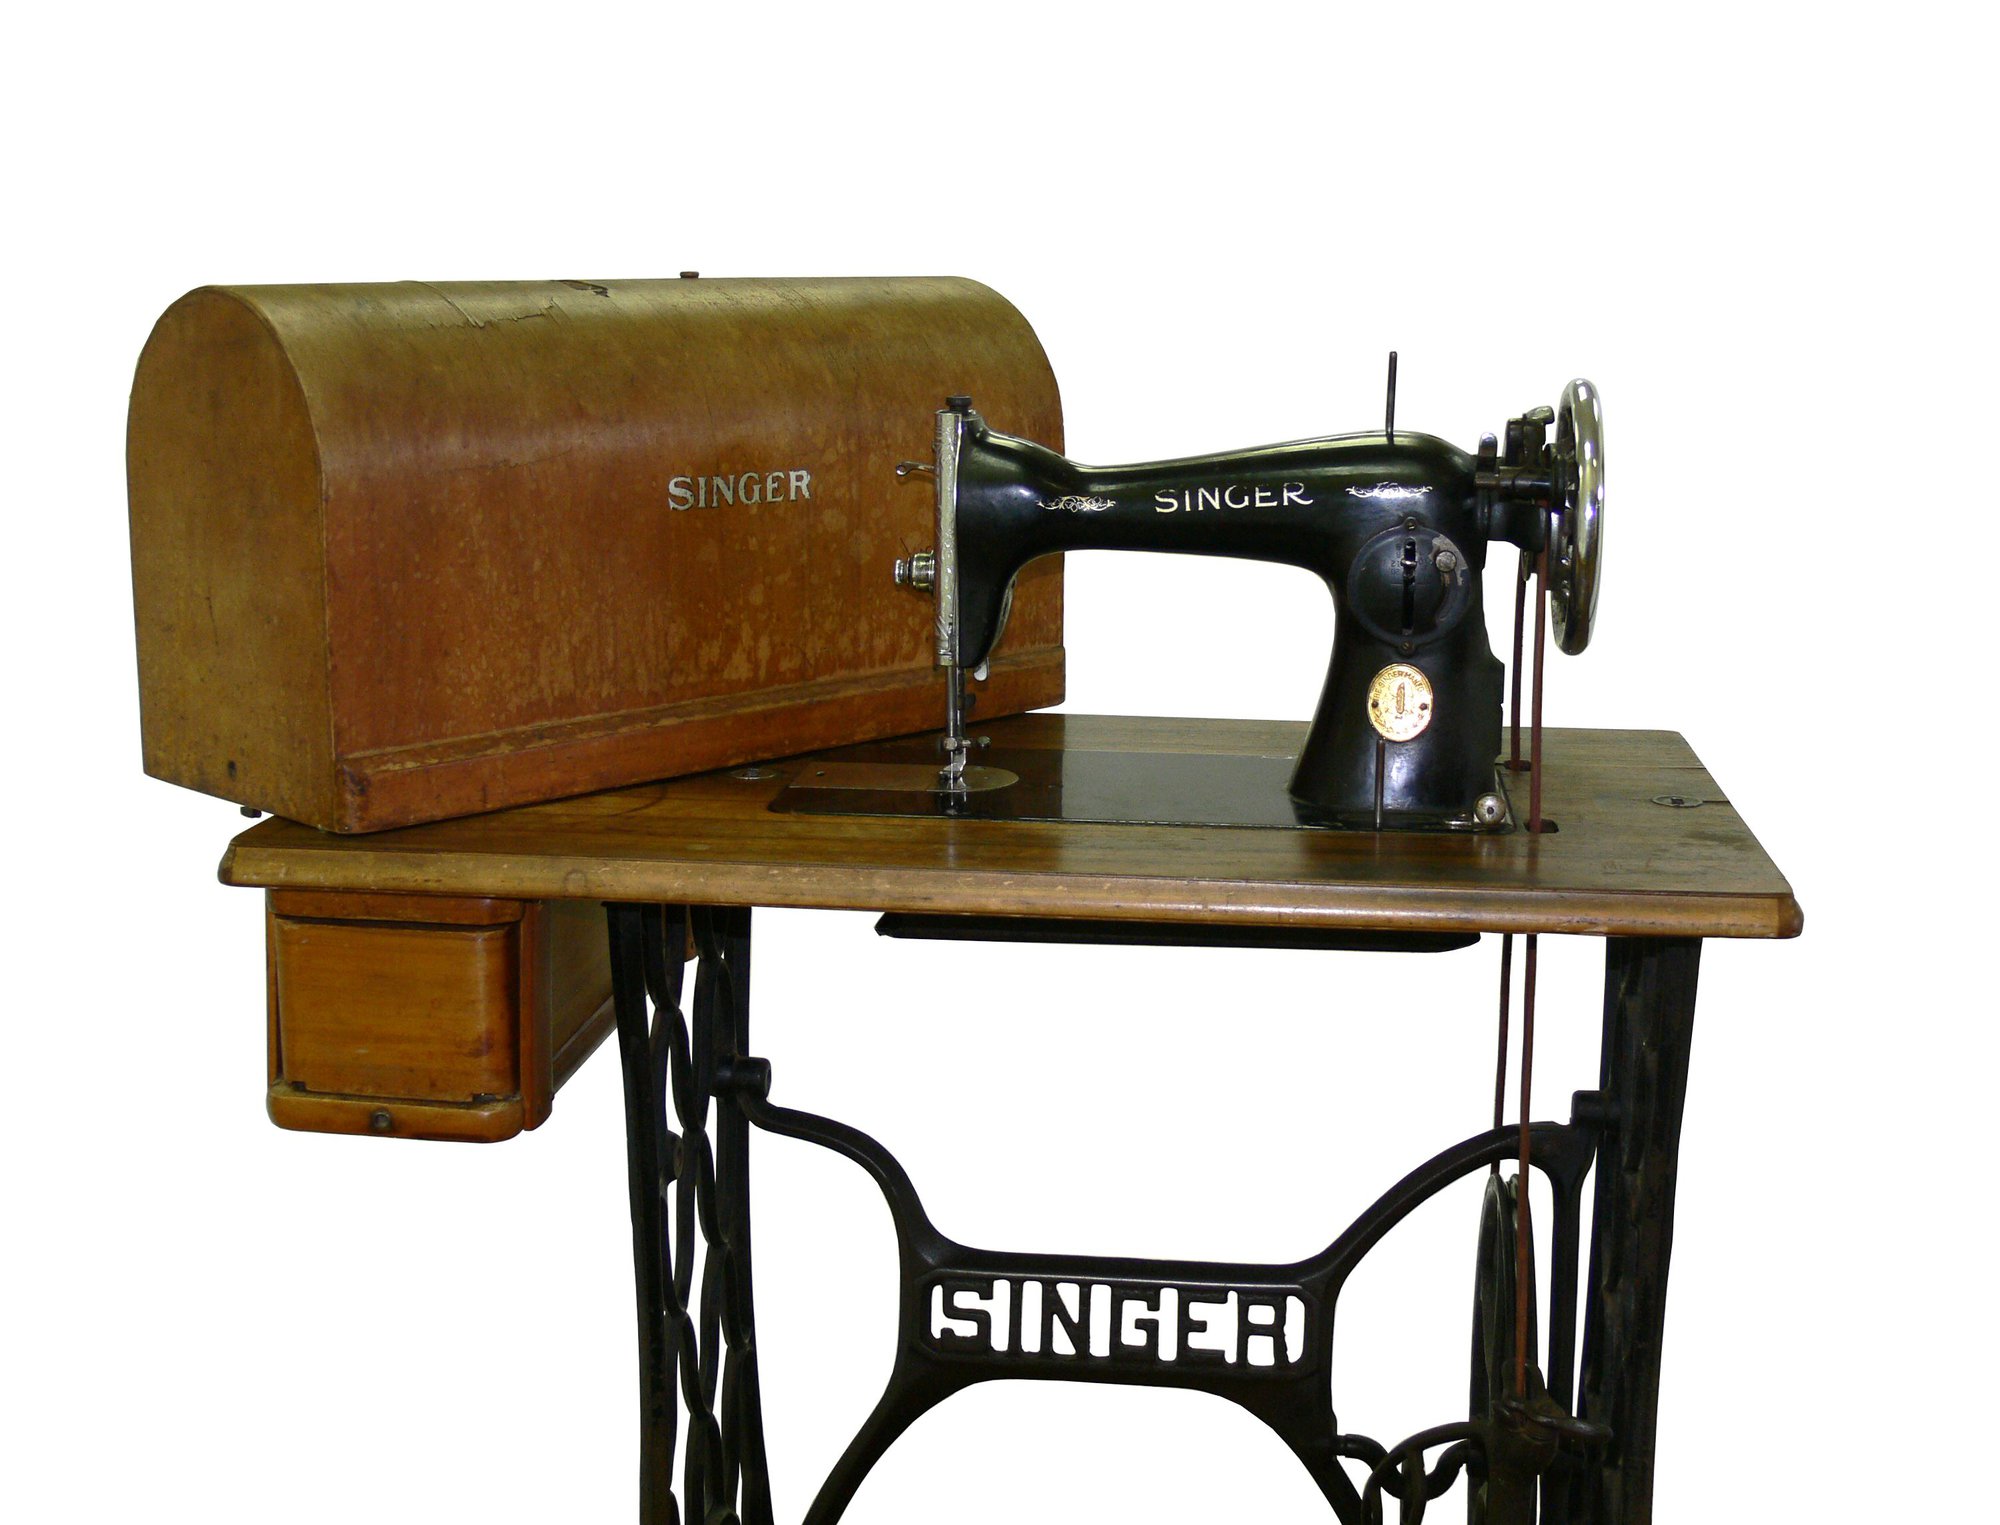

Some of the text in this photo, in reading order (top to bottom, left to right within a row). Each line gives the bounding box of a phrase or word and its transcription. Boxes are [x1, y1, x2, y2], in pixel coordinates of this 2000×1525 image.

[668, 470, 811, 511] SINGER
[1155, 482, 1313, 513] SINGER
[1379, 670, 1404, 688] SINGER
[937, 1280, 1292, 1367] SINGER
